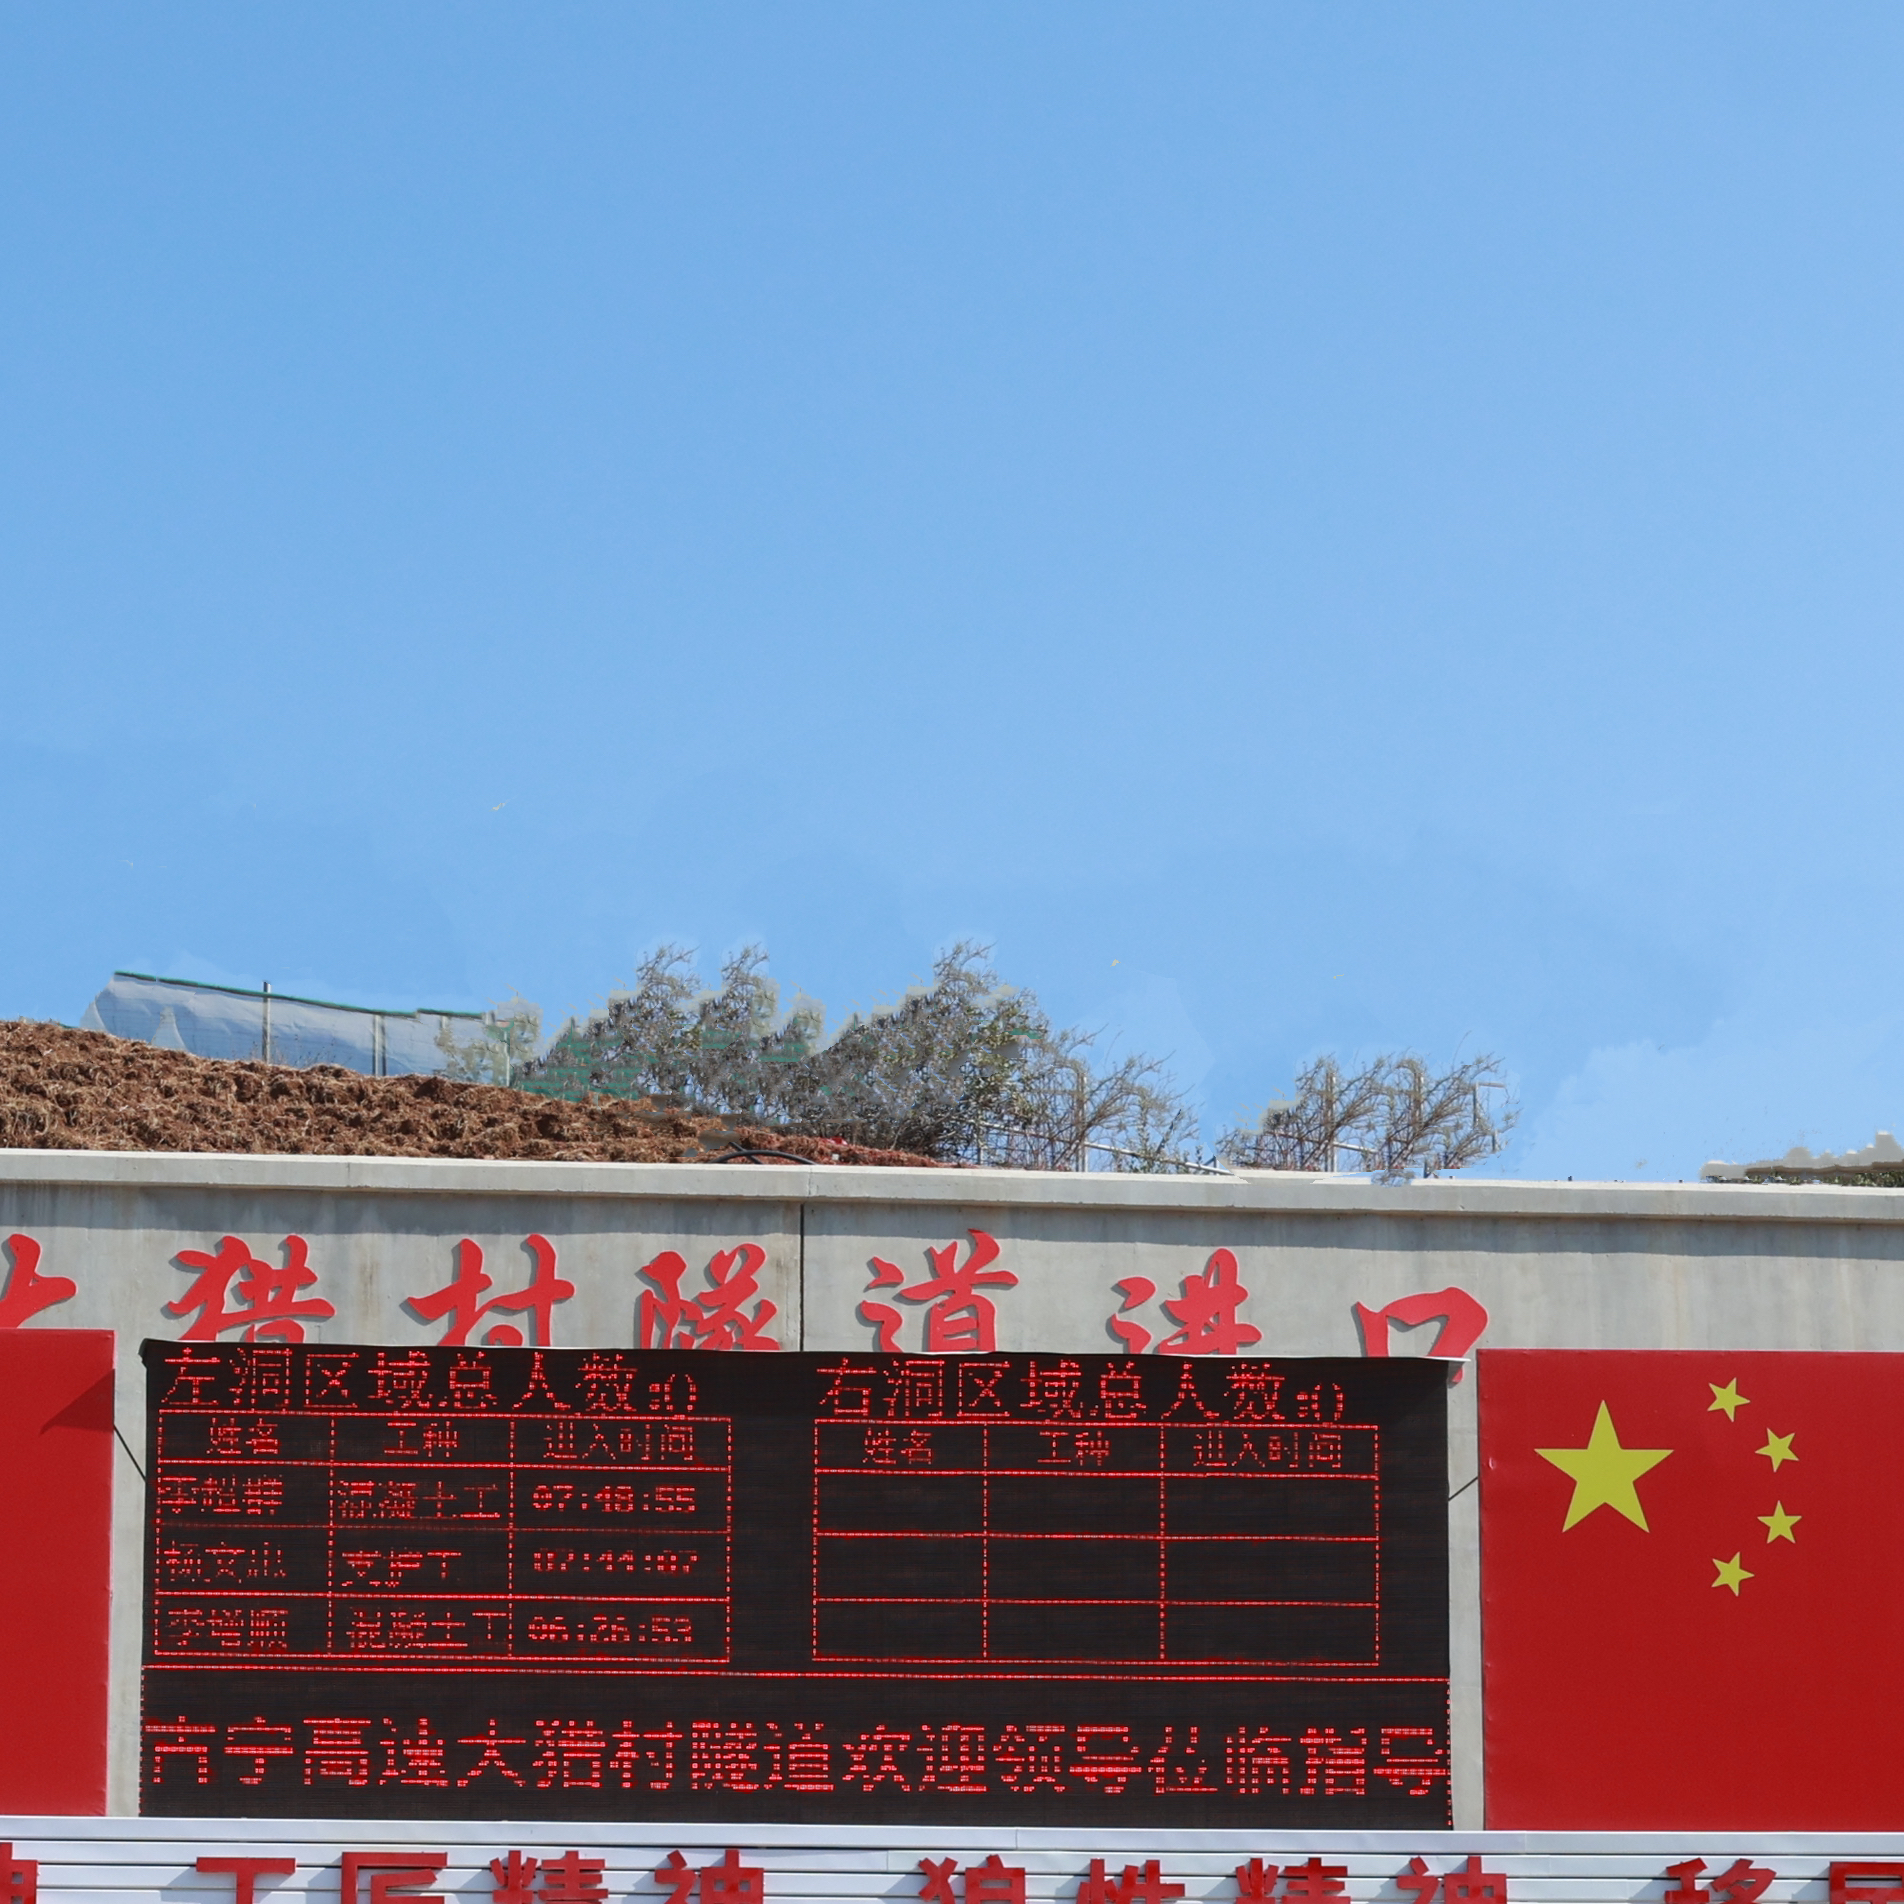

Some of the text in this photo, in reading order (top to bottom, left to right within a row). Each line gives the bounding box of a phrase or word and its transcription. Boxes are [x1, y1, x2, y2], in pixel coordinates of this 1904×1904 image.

[208, 1418, 695, 1461] 姓名 工种 进入时间
[863, 1429, 1342, 1468] 姓名 工种 进入时间
